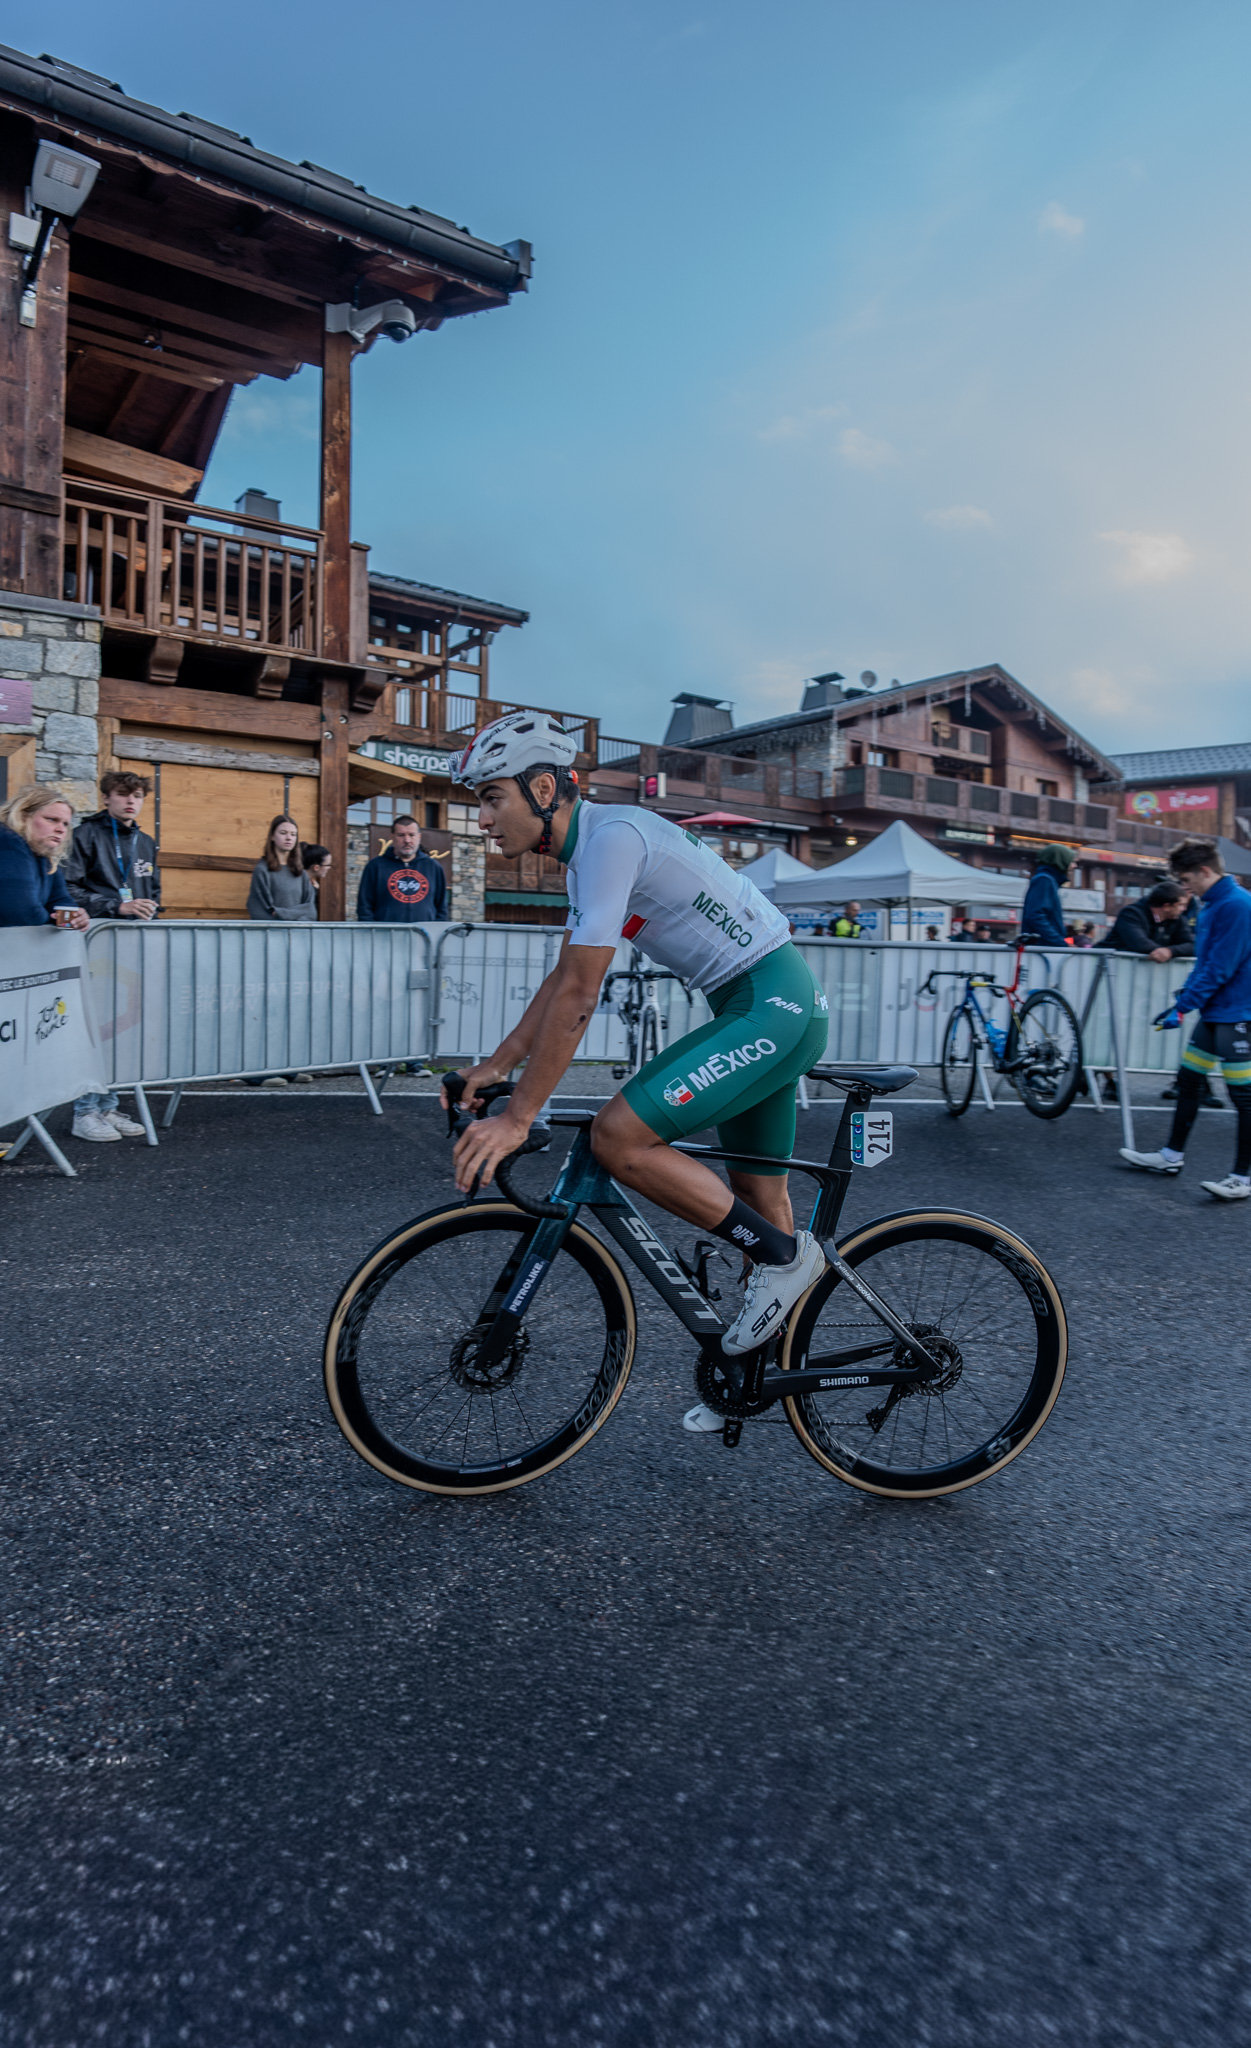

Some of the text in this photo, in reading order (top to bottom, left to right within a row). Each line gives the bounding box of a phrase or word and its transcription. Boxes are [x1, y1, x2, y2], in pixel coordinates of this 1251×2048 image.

[481, 716, 526, 749] SALICE
[868, 1119, 890, 1154] 214
[509, 1262, 544, 1312] PETROLIKE
[619, 1217, 723, 1325] SCOTT
[751, 1298, 782, 1338] SIDI
[819, 1376, 869, 1387] SHIMANO
